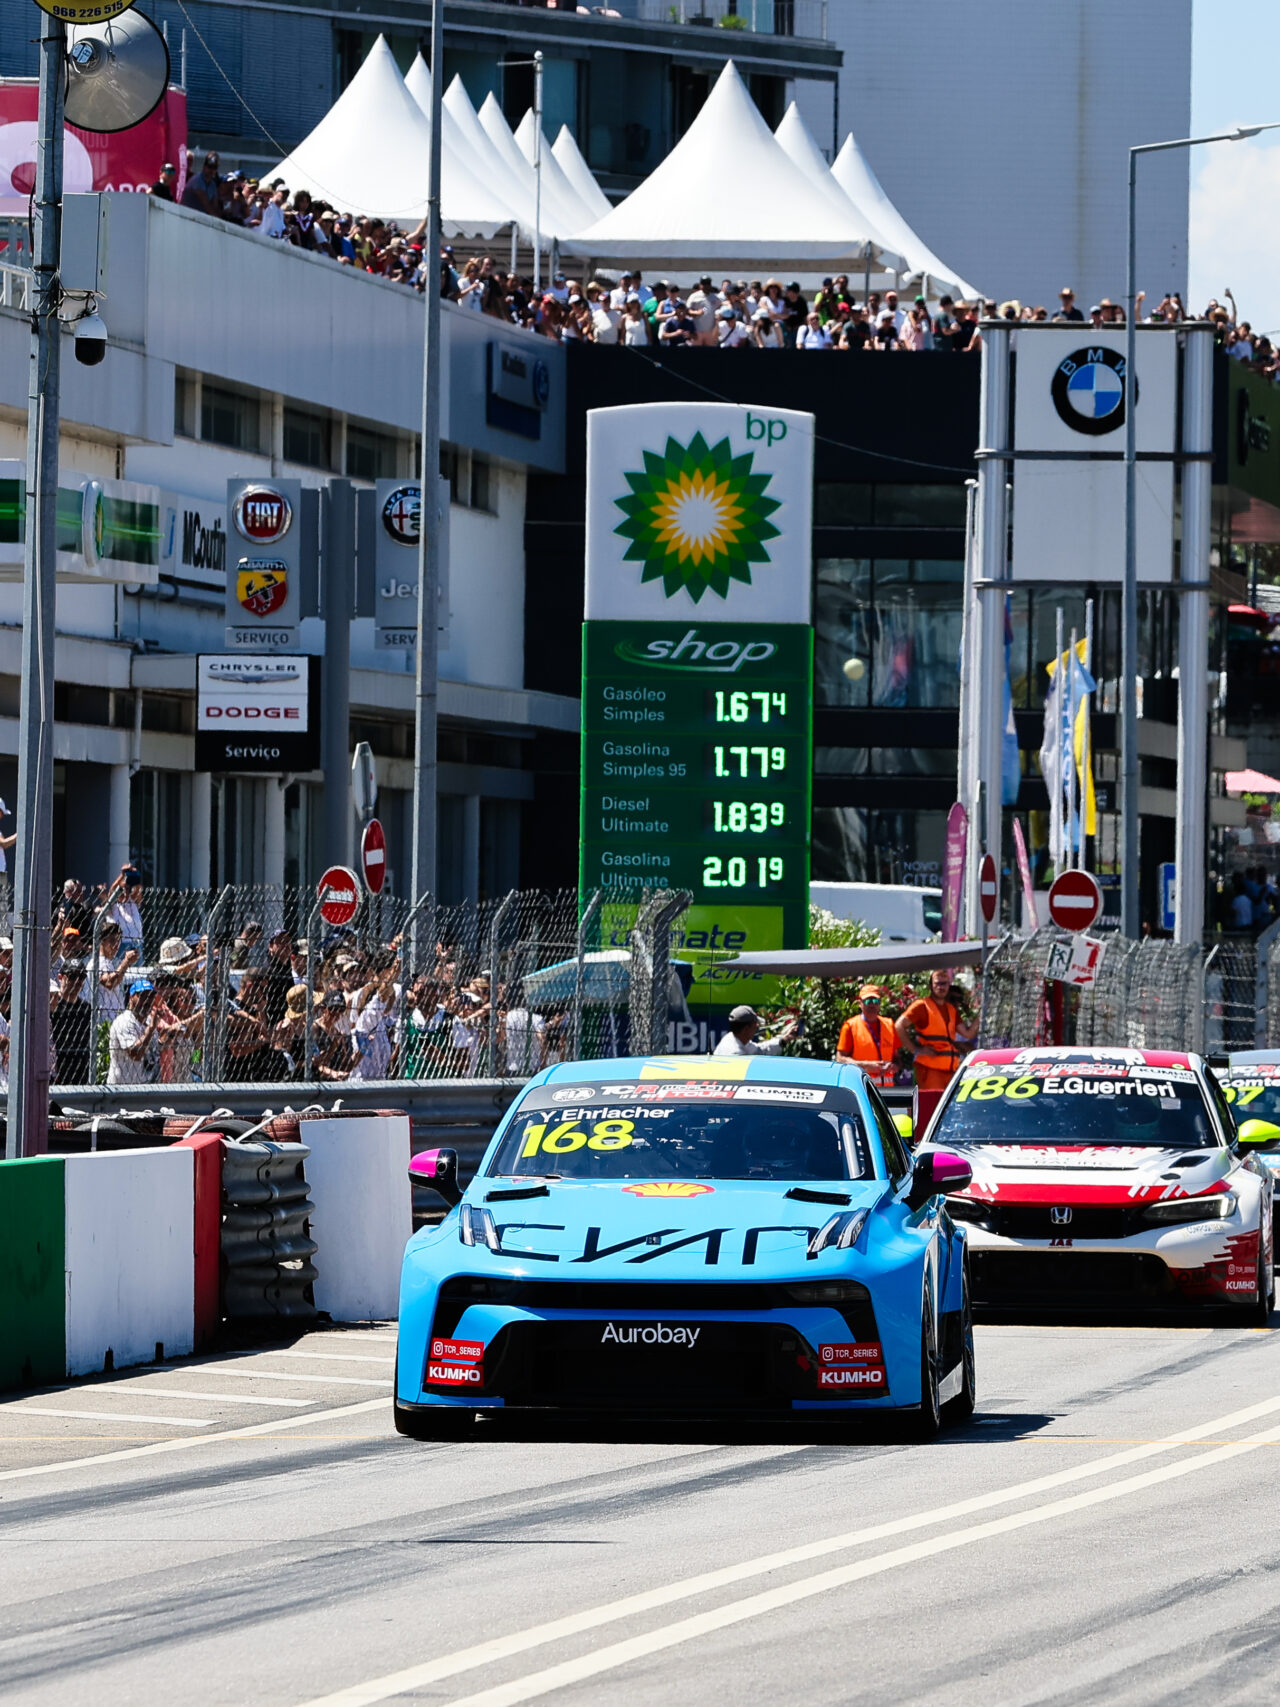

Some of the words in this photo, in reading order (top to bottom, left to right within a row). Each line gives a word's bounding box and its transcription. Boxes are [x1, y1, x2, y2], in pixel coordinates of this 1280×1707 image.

[53, 5, 76, 17] 968
[79, 7, 101, 18] 226
[104, 0, 124, 14] 515
[746, 412, 787, 447] bp
[247, 502, 281, 527] FIAT
[183, 510, 227, 571] MCoutin
[235, 632, 289, 646] SERVIÇO
[384, 634, 417, 645] SERV
[646, 629, 777, 672] shop
[209, 663, 297, 672] CHRYSLER
[603, 686, 666, 701] Gasóleo
[205, 706, 300, 719] DODGE
[603, 706, 665, 723] Simples
[715, 691, 786, 723] 1.674
[225, 744, 280, 761] Serviço
[603, 741, 670, 756] Gasolina
[714, 746, 785, 778] 1.779
[603, 762, 665, 778] Simples
[669, 763, 686, 777] 95
[602, 796, 650, 811] Diesel
[713, 801, 784, 833] 1.839
[602, 817, 669, 833] Ultimate
[602, 852, 671, 867] Gasolina
[601, 872, 669, 888] Ultimate
[903, 873, 942, 886] CITR
[700, 968, 764, 981] ACTIVE
[1139, 1068, 1194, 1078] KUMHO
[554, 1089, 594, 1100] FIA
[601, 1085, 658, 1097] TCR
[747, 1088, 814, 1096] KUMHO
[956, 1076, 1041, 1103] 186
[1042, 1077, 1176, 1098] E.Guerrieri
[540, 1107, 674, 1123] Y.Ehrlacher
[521, 1119, 635, 1158] 168
[1049, 1239, 1073, 1247] JAS
[1226, 1281, 1256, 1290] KUMHO
[601, 1322, 701, 1349] Aurobay
[444, 1345, 481, 1356] TCR_SERIES
[835, 1349, 878, 1359] TCR_SERIES
[429, 1366, 481, 1382] KUMHO
[821, 1370, 882, 1384] KUMHO
